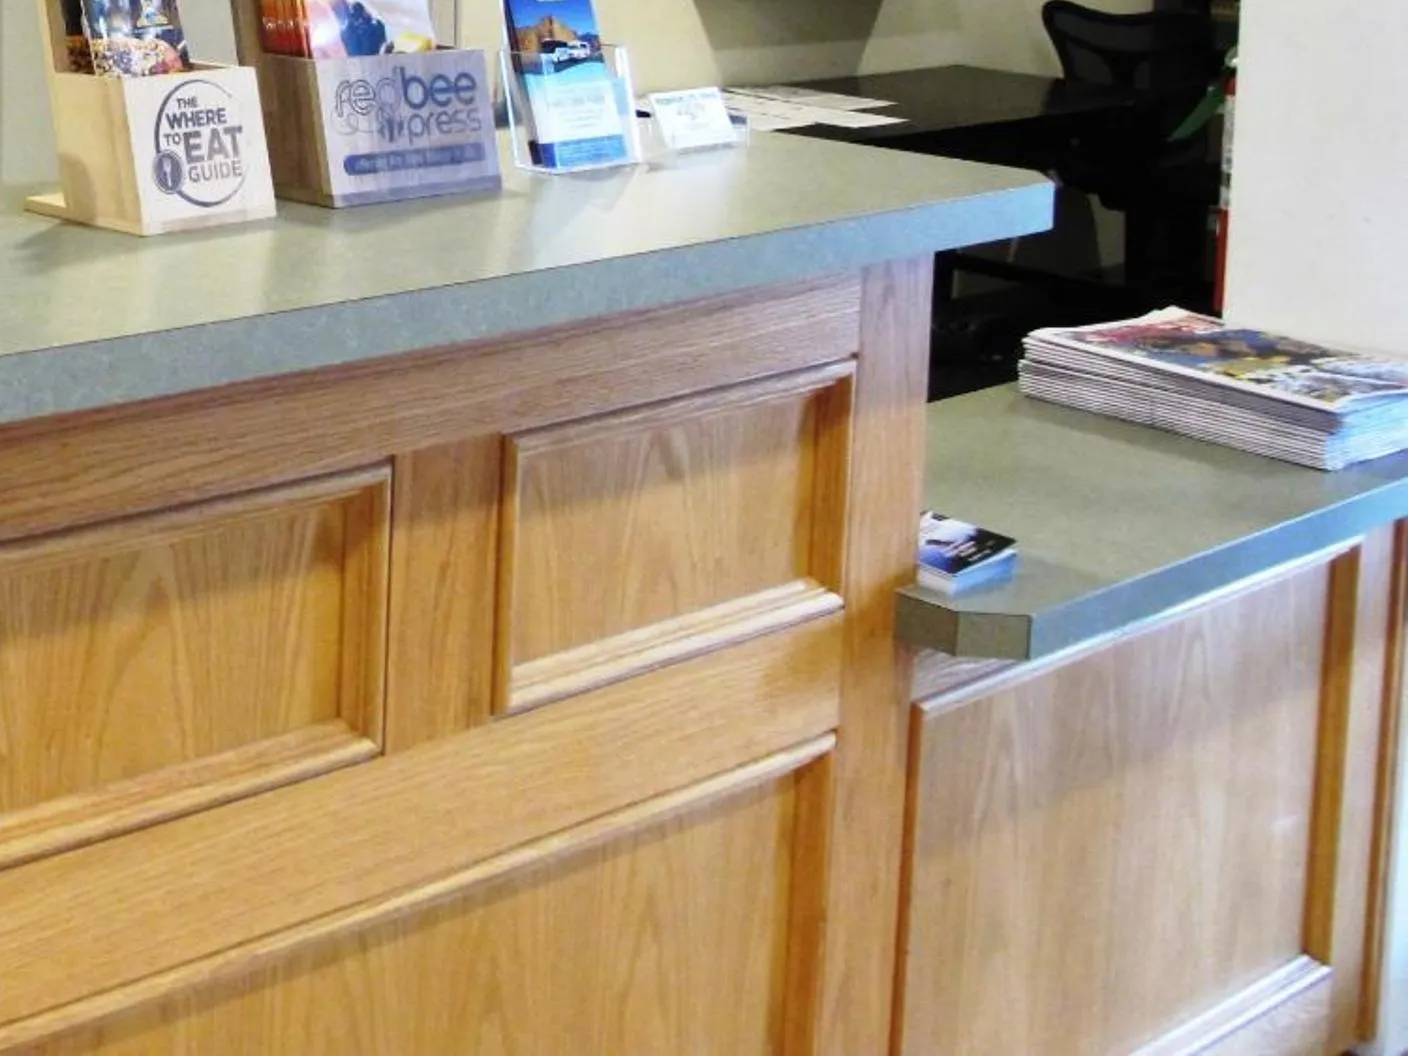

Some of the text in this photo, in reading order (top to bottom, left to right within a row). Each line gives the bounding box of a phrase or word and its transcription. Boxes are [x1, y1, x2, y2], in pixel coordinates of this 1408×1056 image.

[176, 96, 198, 110] THE
[165, 107, 227, 130] WHERE
[407, 108, 483, 145] press
[163, 125, 243, 165] TO EAT
[188, 160, 243, 184] GUIDE
